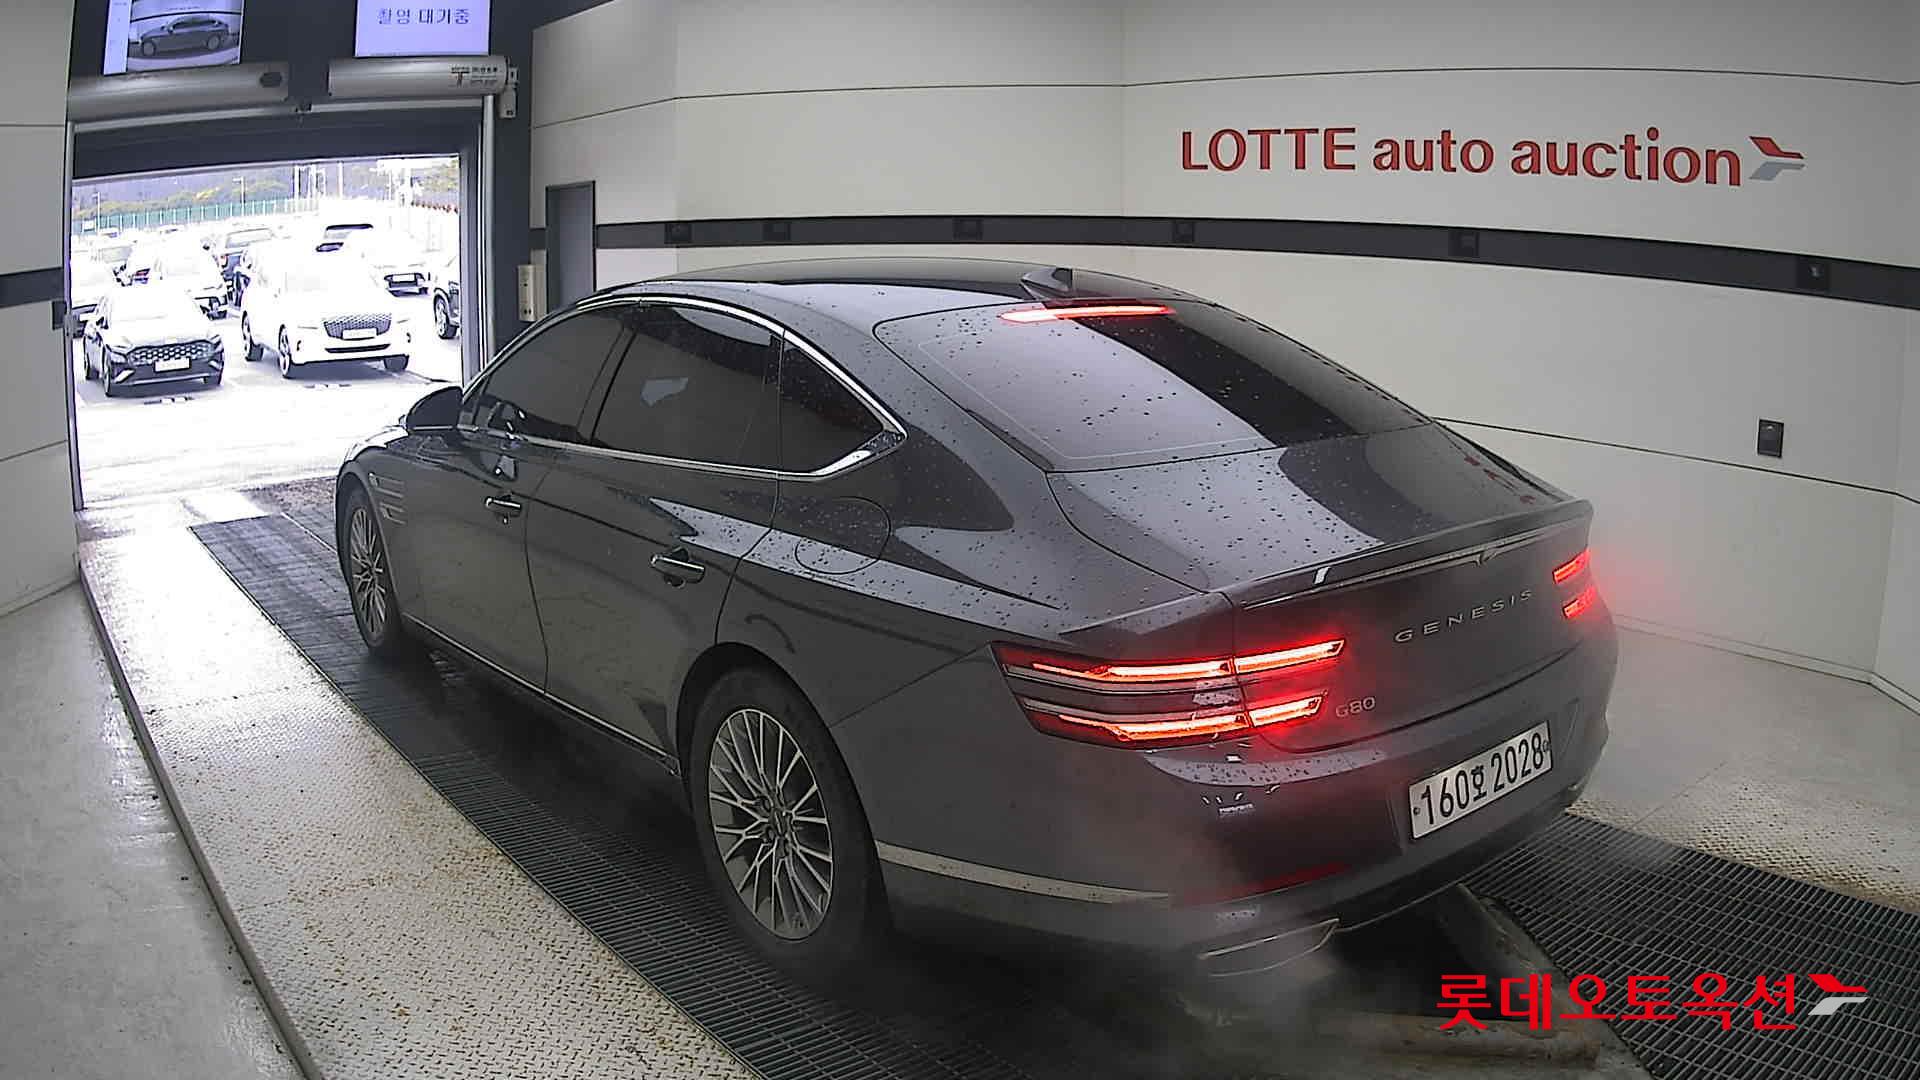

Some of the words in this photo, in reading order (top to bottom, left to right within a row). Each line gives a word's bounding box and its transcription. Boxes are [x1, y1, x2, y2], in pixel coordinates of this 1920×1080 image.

[418, 8, 470, 25] 대기중
[1182, 127, 1357, 171] LOTTE
[1373, 130, 1495, 173] auto
[1511, 127, 1742, 186] auction
[1394, 588, 1533, 643] GENESIS
[1335, 695, 1377, 719] G80
